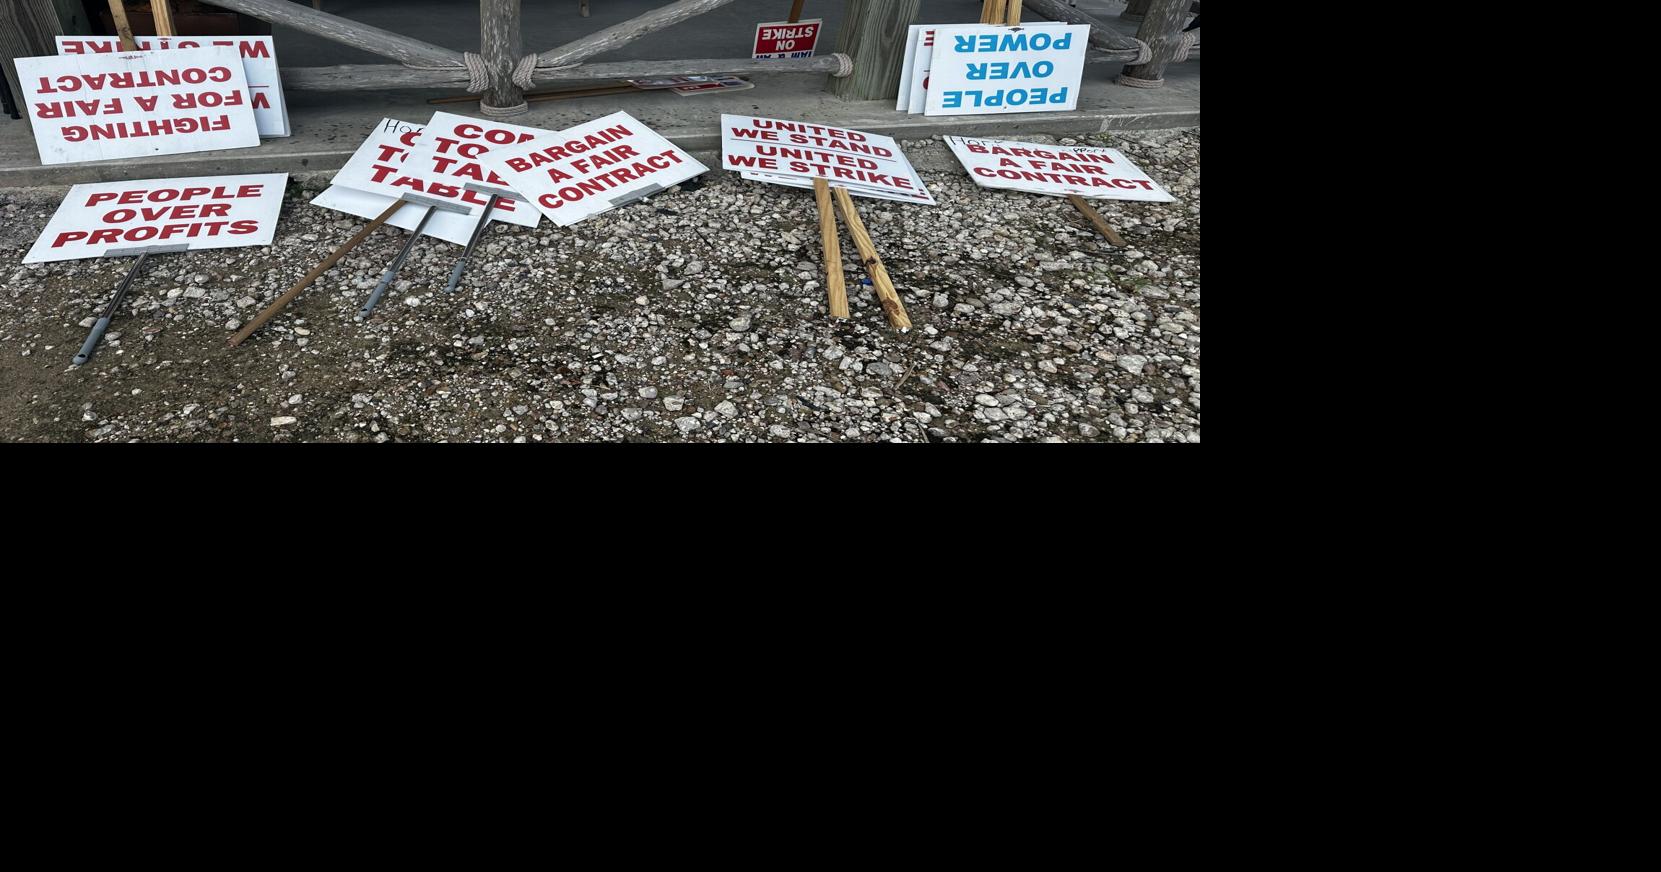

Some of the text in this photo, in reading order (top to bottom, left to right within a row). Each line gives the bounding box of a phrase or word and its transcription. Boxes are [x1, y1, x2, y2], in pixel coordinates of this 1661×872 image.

[762, 26, 814, 40] STRIKE
[953, 31, 1073, 54] POWER
[775, 39, 795, 51] ON
[37, 66, 232, 94] CONTRACT
[965, 60, 1055, 81] OVER
[36, 98, 123, 119] FAIR
[135, 96, 157, 112] A
[172, 90, 243, 109] FOR
[942, 86, 1069, 109] PEOPLE
[61, 114, 231, 142] FIGHTING
[752, 119, 867, 142] UNITED
[505, 124, 634, 173] BARGAIN
[731, 127, 893, 158] WE STAND
[966, 143, 1114, 164] BARGAIN
[547, 144, 640, 184] A FAIR
[755, 144, 879, 171] UNITED
[999, 157, 1109, 175] A FAIR
[538, 149, 683, 209] CONTRACT
[728, 154, 914, 190] WE STRIKE
[973, 167, 1155, 190] CONTRACT
[85, 185, 264, 208] PEOPLE
[371, 164, 516, 212] TABLE
[102, 203, 232, 224] OVER
[51, 220, 259, 249] PROFITS
